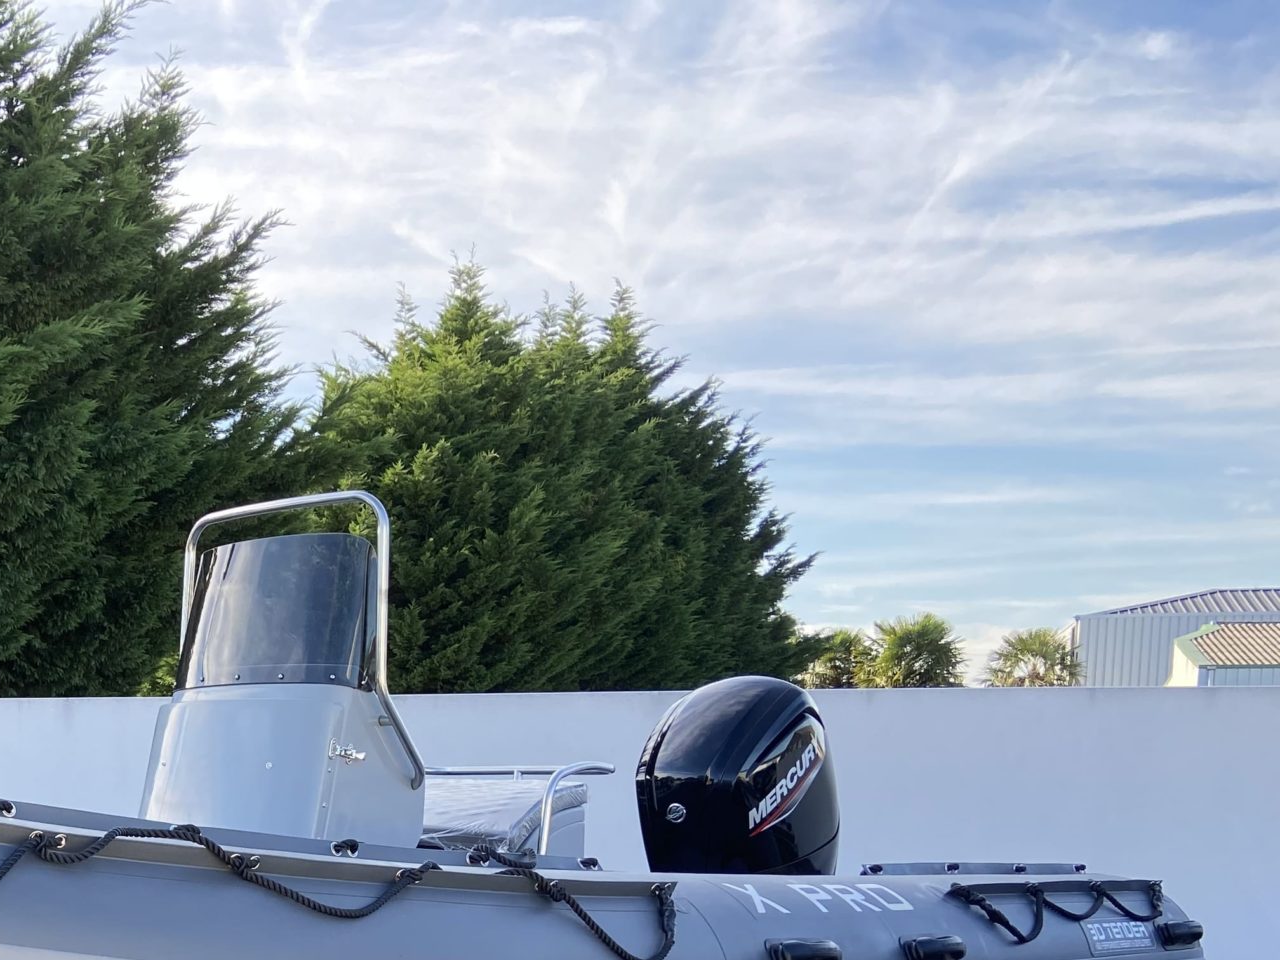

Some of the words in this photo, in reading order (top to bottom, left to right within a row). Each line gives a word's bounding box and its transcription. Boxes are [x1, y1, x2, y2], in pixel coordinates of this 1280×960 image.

[721, 883, 792, 914] X
[786, 884, 915, 913] PRO
[1102, 921, 1150, 940] TENDER
